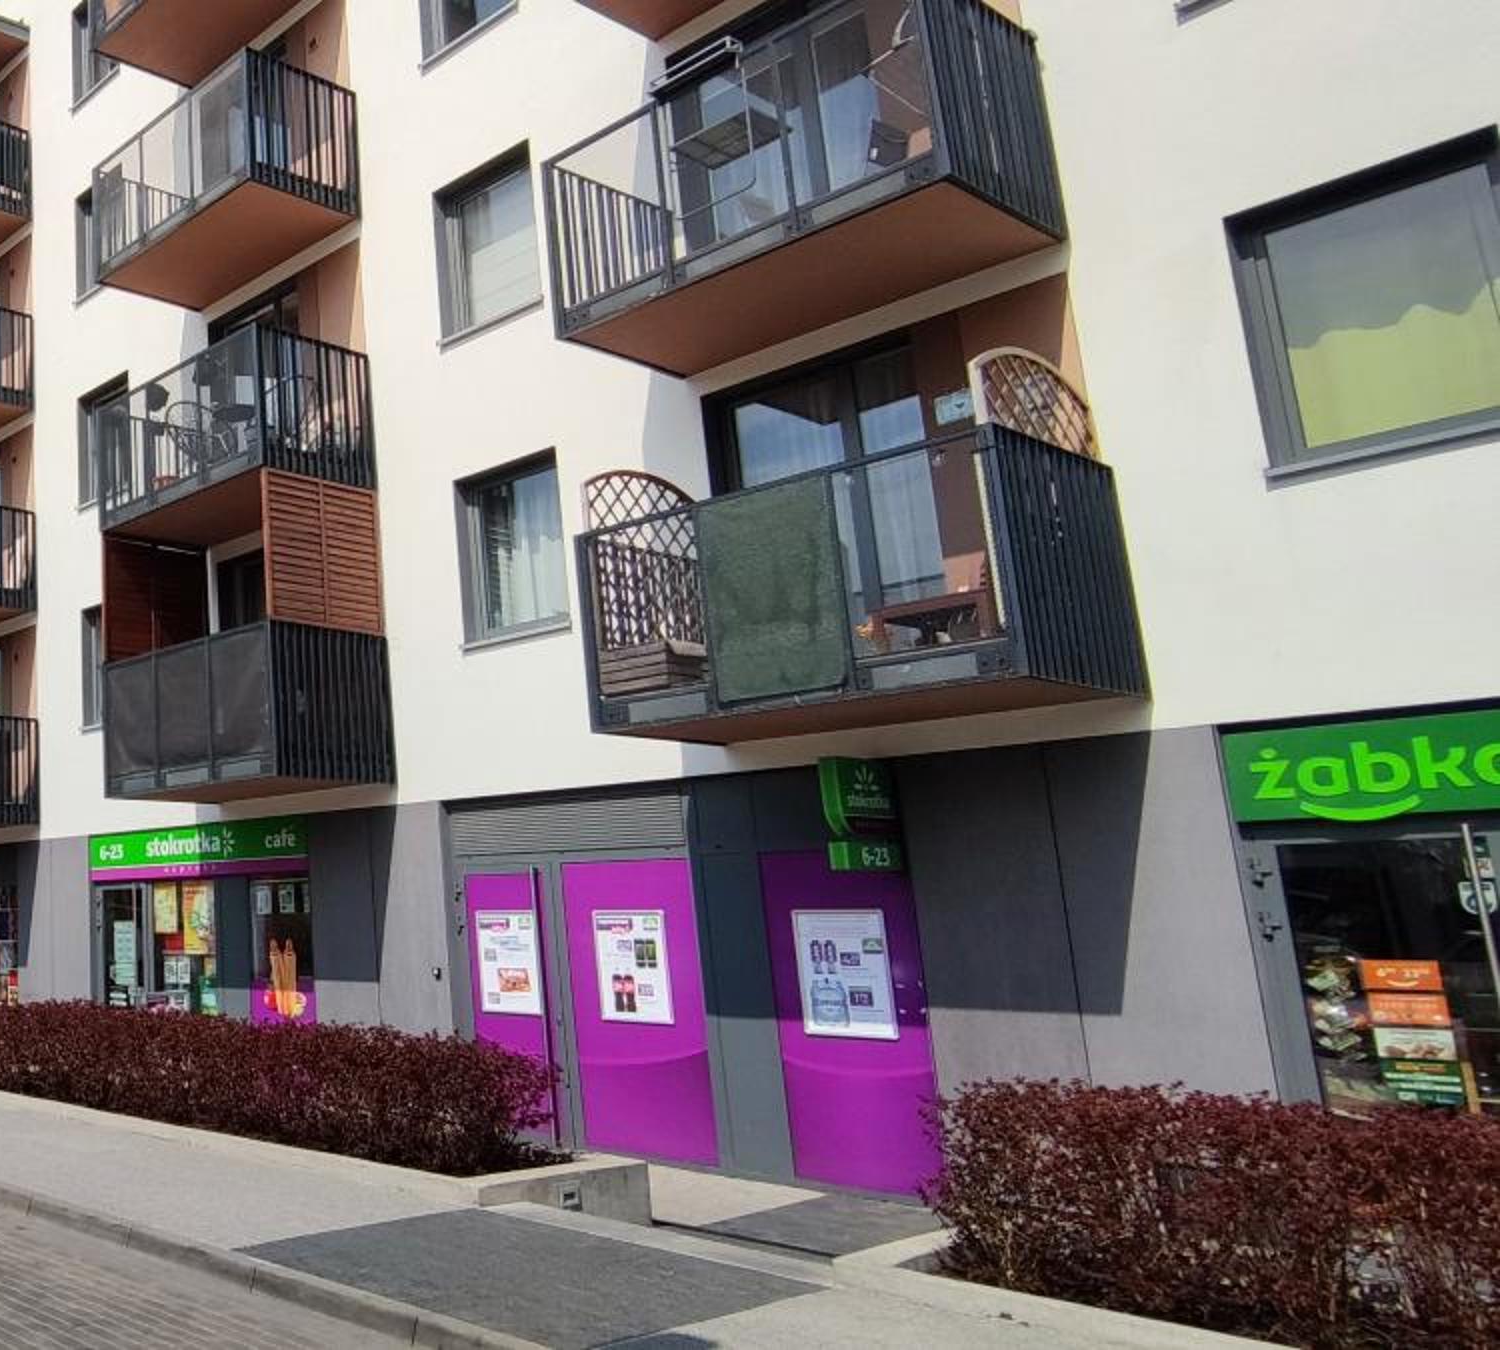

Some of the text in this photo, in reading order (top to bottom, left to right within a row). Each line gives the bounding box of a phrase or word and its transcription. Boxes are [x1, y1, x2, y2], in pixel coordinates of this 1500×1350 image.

[99, 843, 124, 861] 6-23
[145, 831, 221, 857] stokrotka
[861, 847, 891, 867] 6-23
